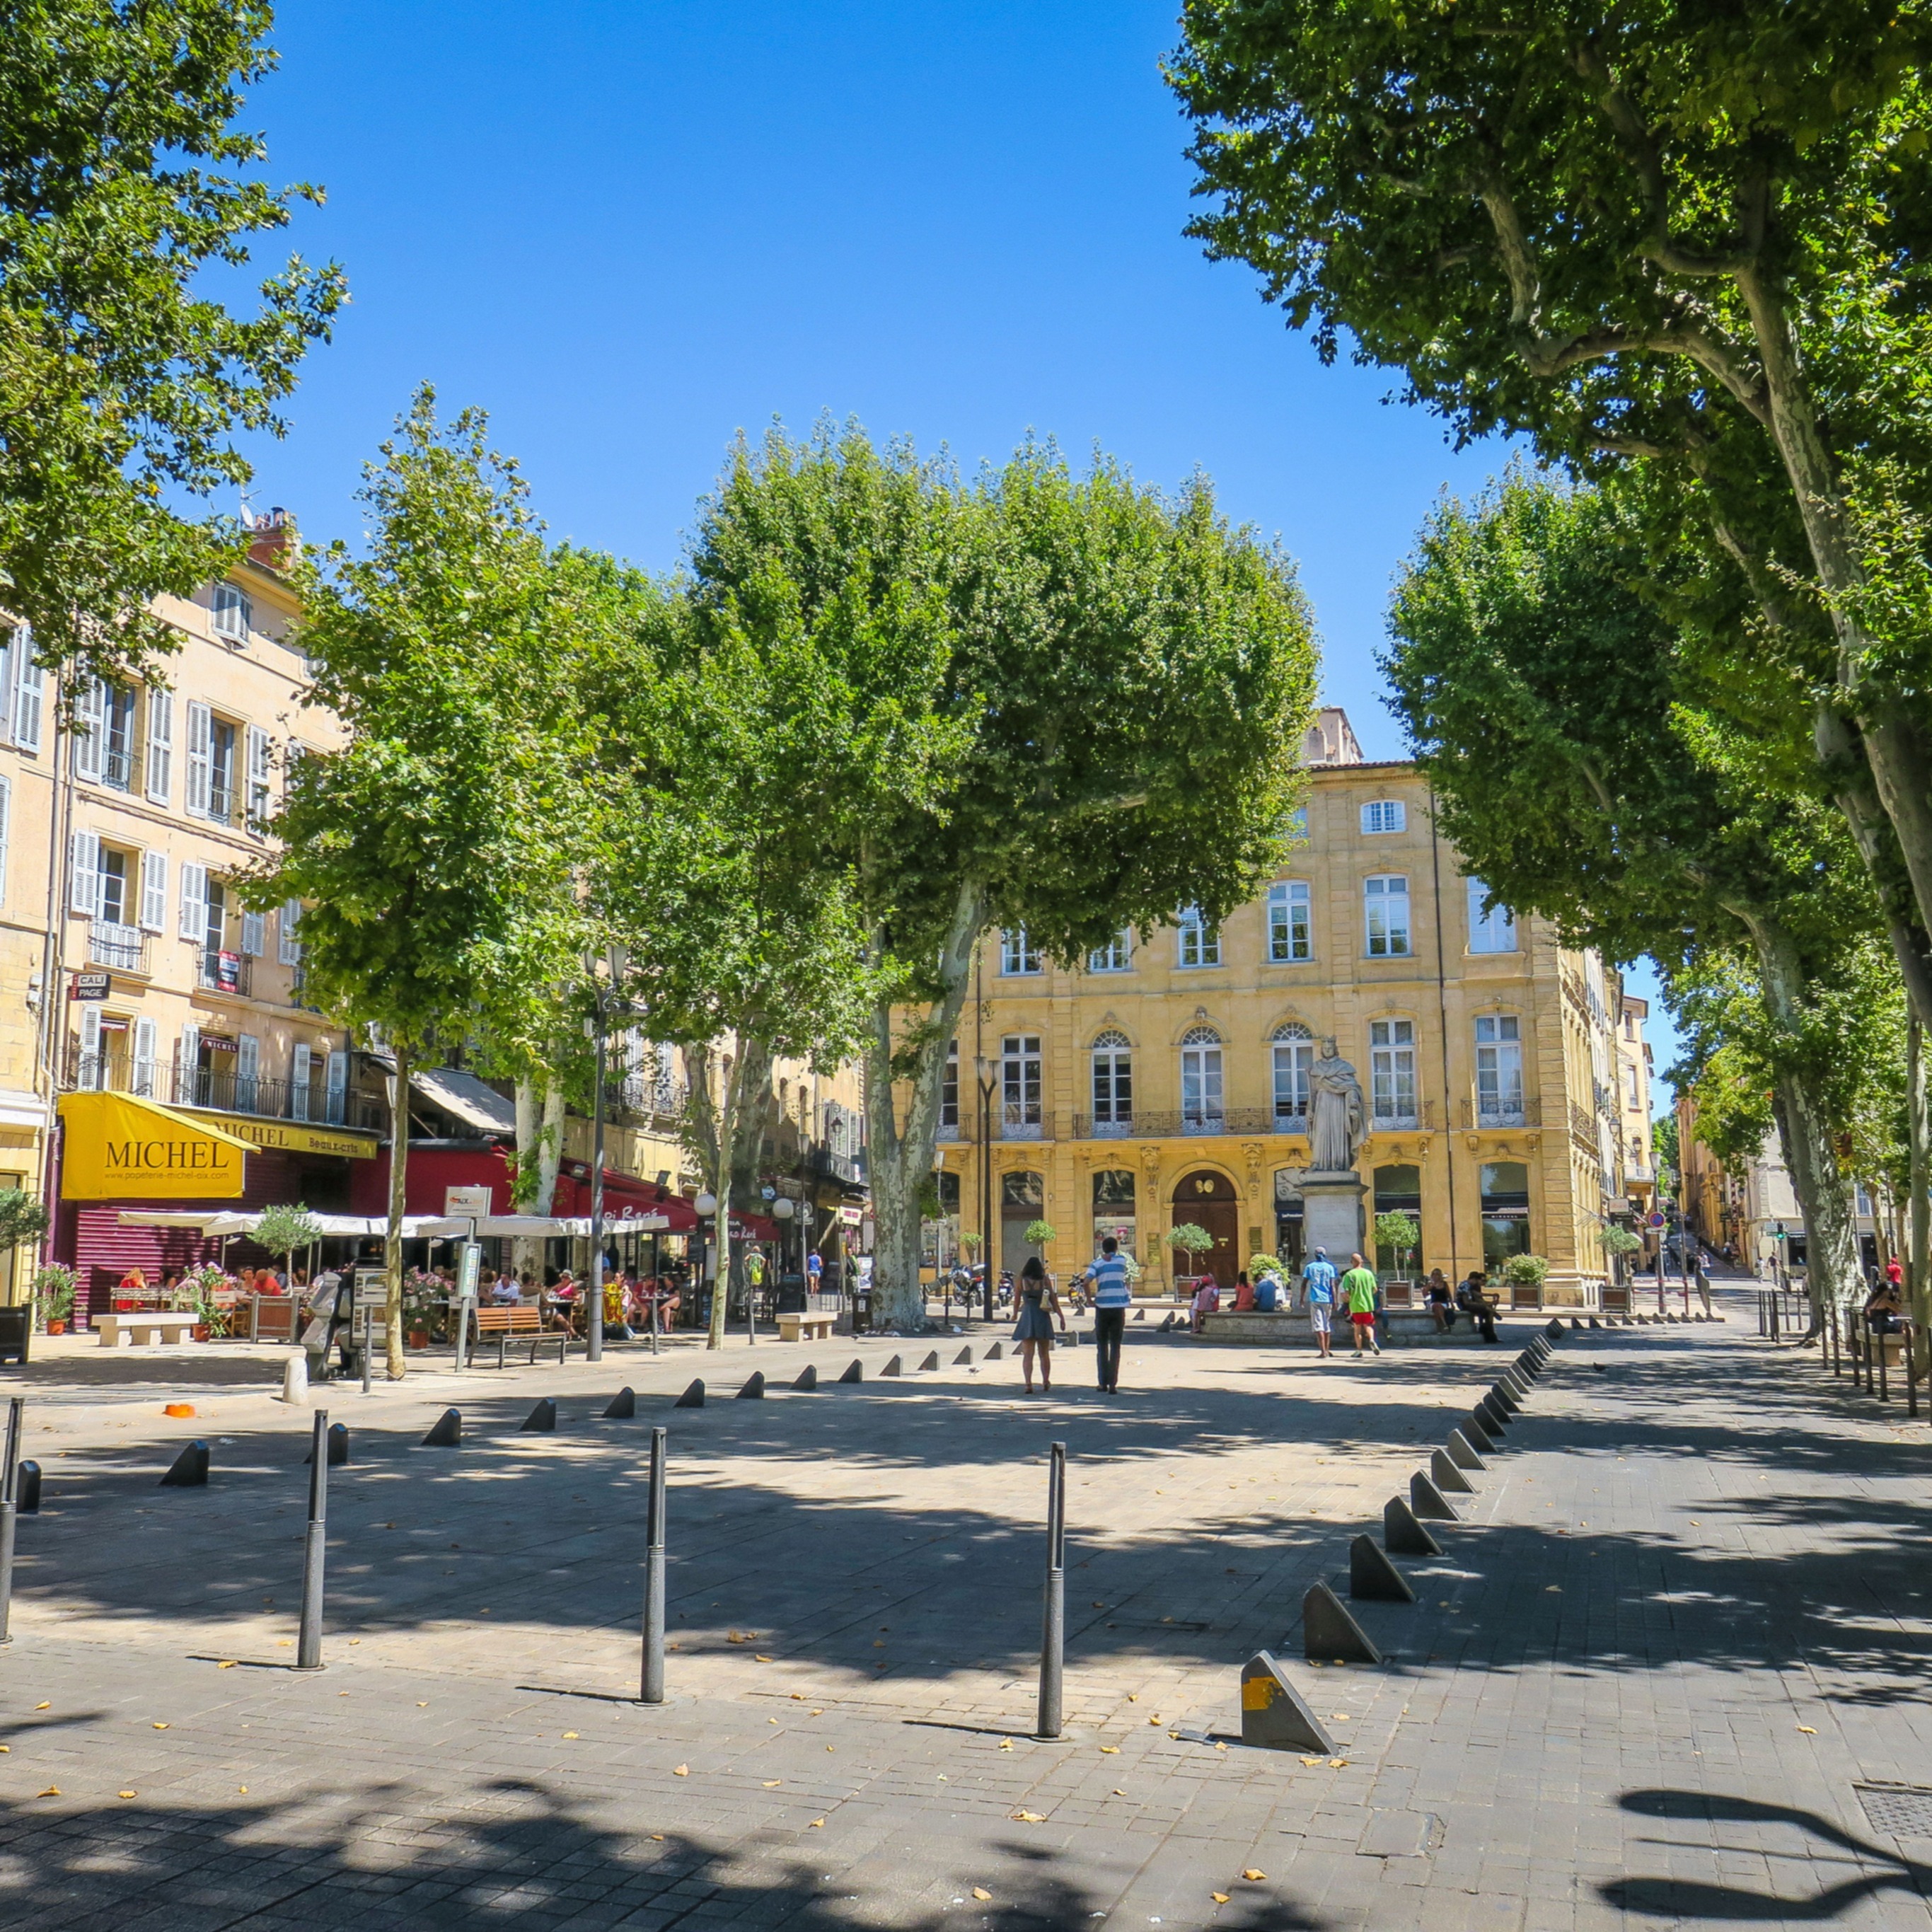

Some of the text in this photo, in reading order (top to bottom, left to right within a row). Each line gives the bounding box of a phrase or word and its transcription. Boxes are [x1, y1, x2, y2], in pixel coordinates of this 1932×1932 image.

[80, 976, 105, 985] CALI
[79, 988, 103, 997] PAGE
[207, 1041, 238, 1052] MICHEL
[105, 1141, 229, 1168] MICHEL
[104, 1171, 229, 1180] www.papeterie-michel-aix.com
[603, 1205, 659, 1220] oi René
